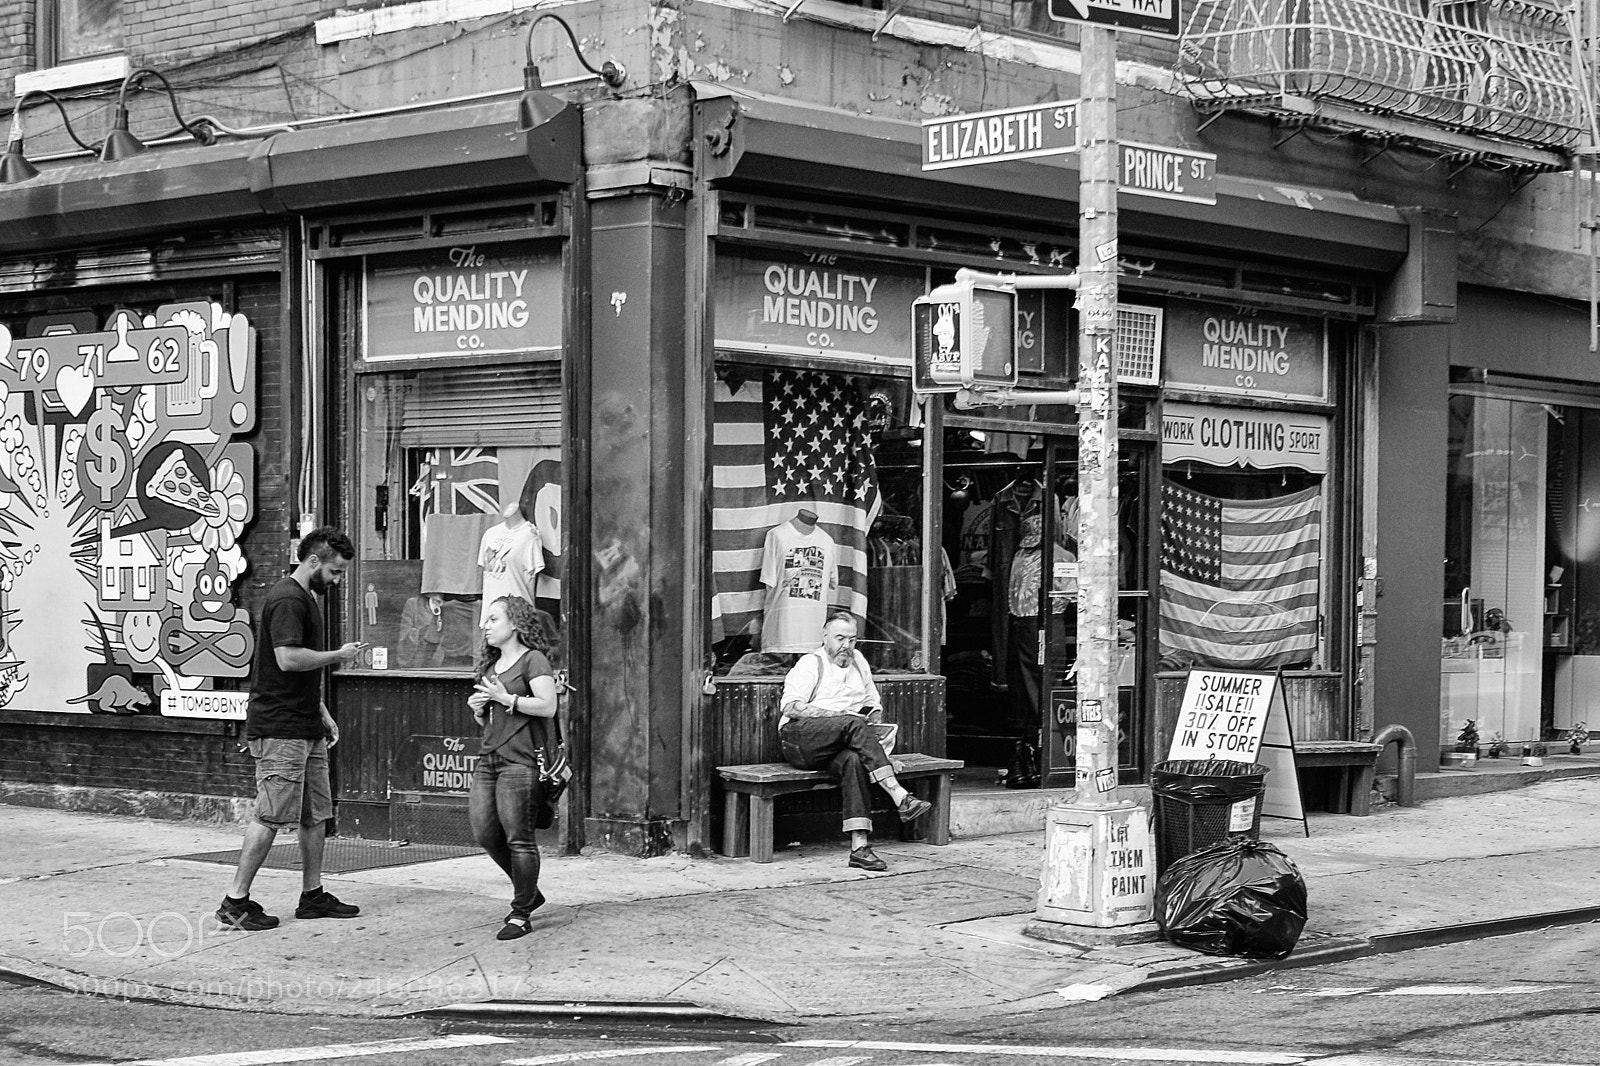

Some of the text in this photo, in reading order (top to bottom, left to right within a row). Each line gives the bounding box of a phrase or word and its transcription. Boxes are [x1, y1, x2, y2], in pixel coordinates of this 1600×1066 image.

[928, 106, 1075, 162] ELIZABETH ST
[1124, 149, 1207, 193] PRINCE ST
[449, 245, 485, 268] The
[413, 269, 528, 304] QUALITY
[764, 265, 877, 303] QUALITY
[413, 300, 530, 333] MENDING
[763, 295, 879, 334] MENDING
[456, 335, 485, 349] CO.
[806, 332, 835, 347] CO.
[1203, 317, 1289, 348] QUALITY
[17, 348, 50, 382] 79
[78, 344, 104, 377] 71
[147, 337, 180, 374] 62
[1202, 343, 1290, 375] MENDING
[1235, 374, 1257, 387] CO.
[1163, 417, 1321, 452] WORK CLOTHING SPORT
[1200, 675, 1262, 696] SUMMER
[1194, 693, 1255, 714] !!SALE!!
[1185, 711, 1257, 733] 30% OFF
[443, 737, 466, 752] The
[1181, 730, 1258, 753] IN STORE
[423, 752, 481, 771] QUALIT
[423, 770, 474, 789] MENDIN
[1109, 848, 1143, 868] THEM
[1112, 875, 1146, 896] PAINT
